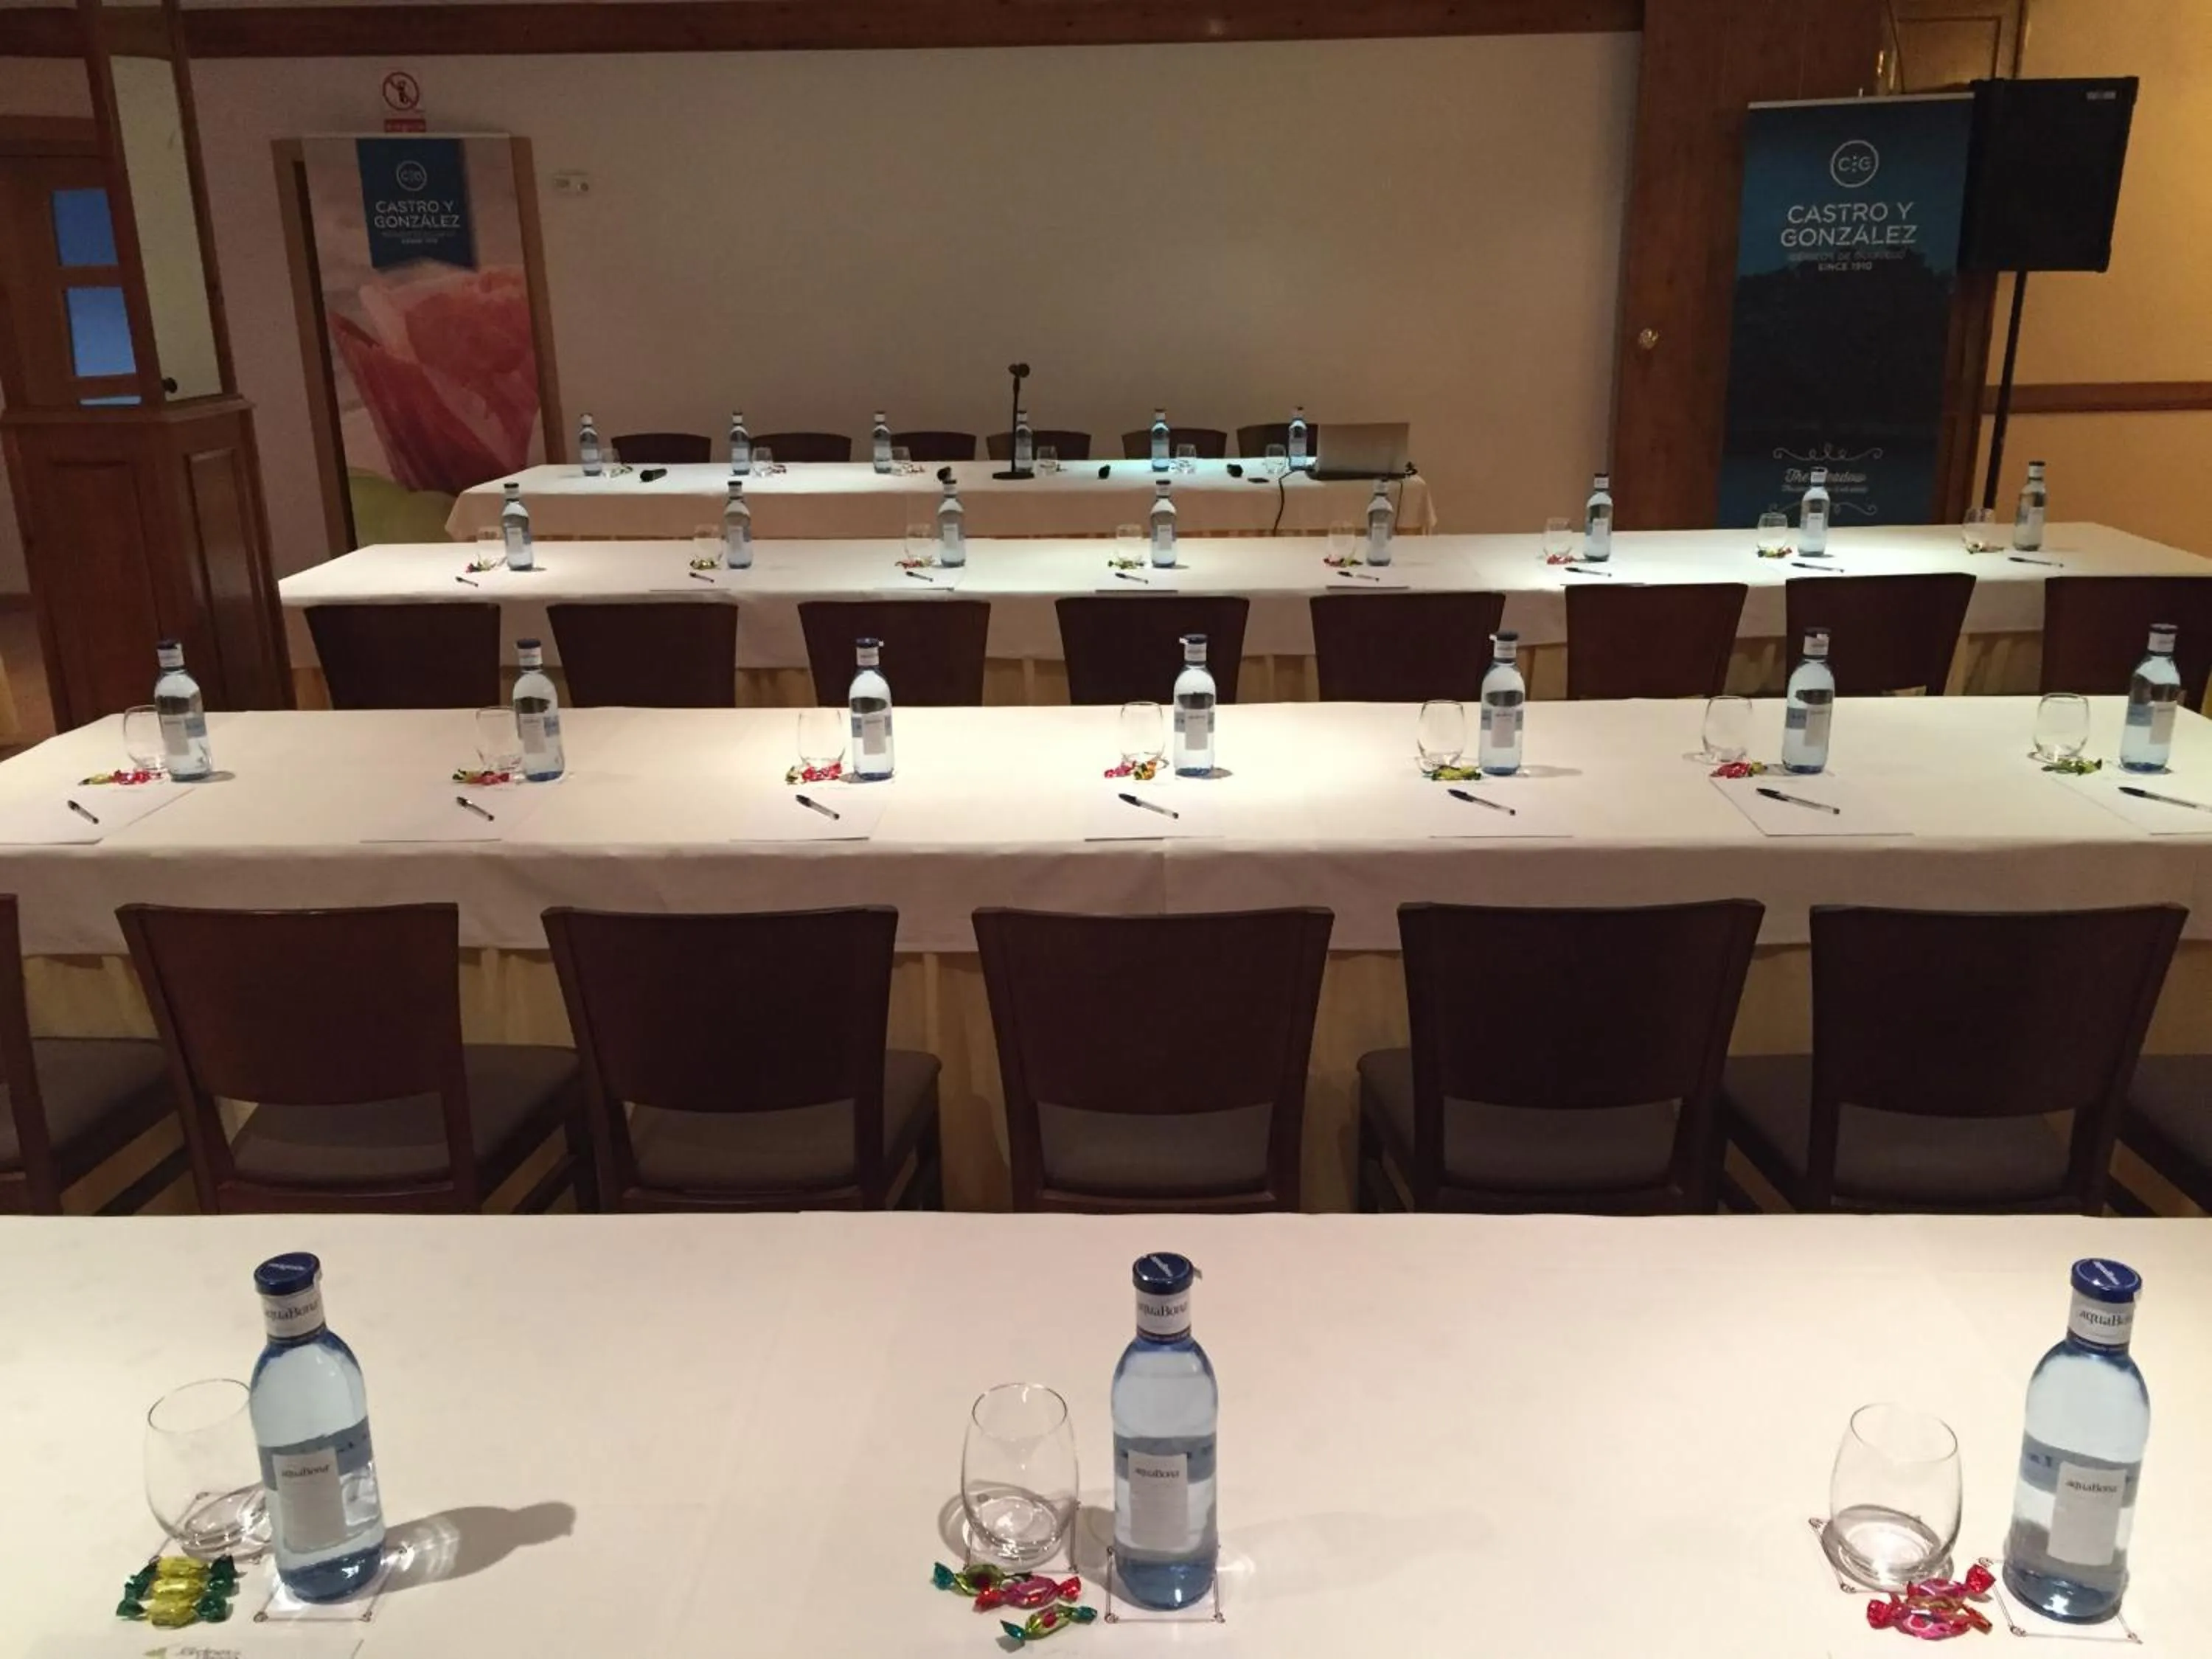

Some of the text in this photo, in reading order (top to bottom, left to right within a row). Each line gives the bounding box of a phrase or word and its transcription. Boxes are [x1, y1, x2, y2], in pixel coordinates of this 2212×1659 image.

[375, 200, 454, 213] CASTRO Y
[1787, 201, 1914, 223] CASTRO Y
[1781, 223, 1918, 247] GONZÁLEZ
